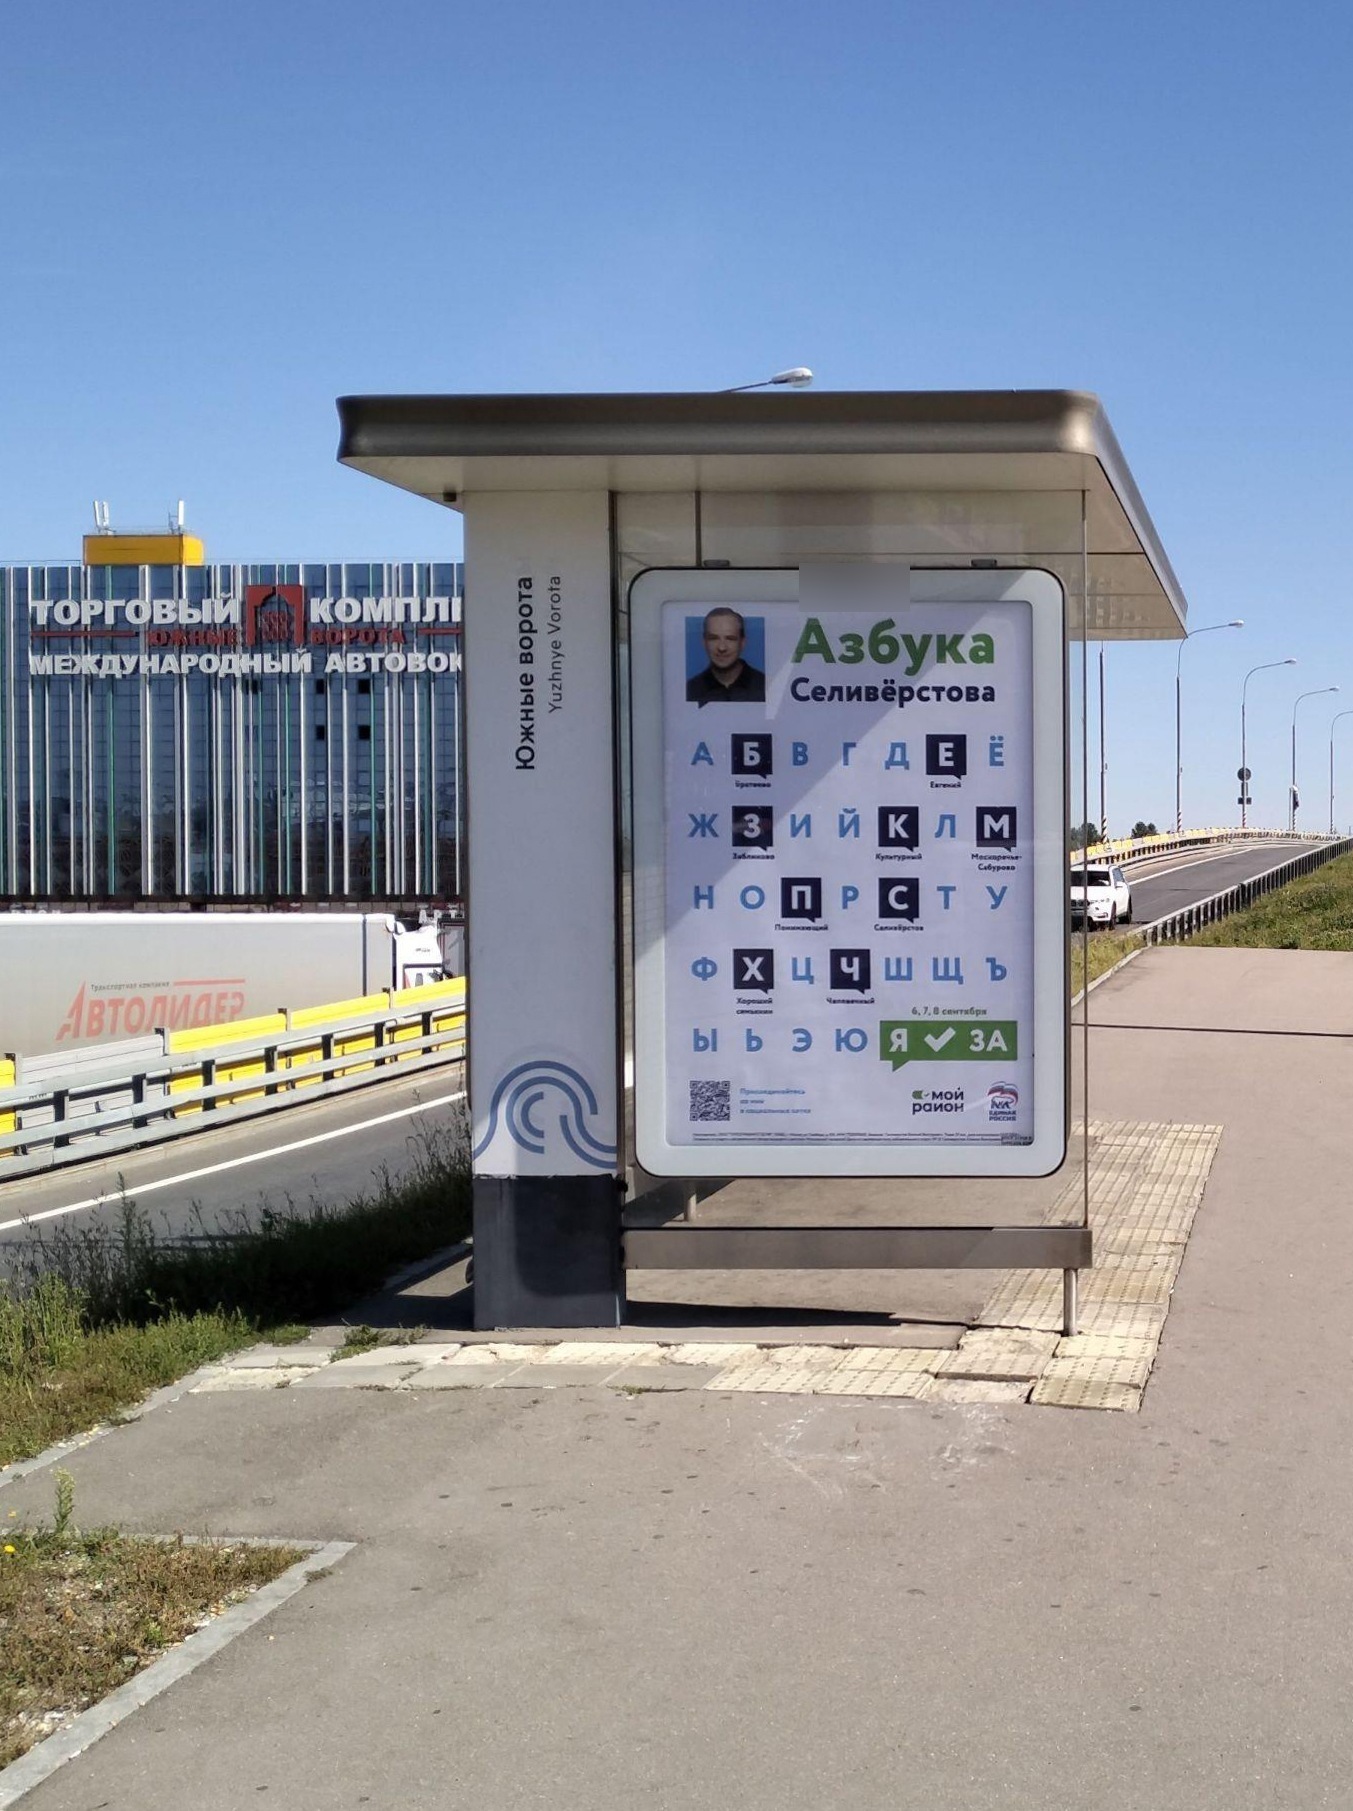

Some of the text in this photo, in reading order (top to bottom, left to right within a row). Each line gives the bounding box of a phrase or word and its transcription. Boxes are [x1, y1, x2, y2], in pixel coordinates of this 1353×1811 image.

[30, 592, 240, 626] ТОРГОВЫЙ
[147, 628, 406, 646] ЮЖНЫЕ ВОРОТА
[547, 576, 565, 713] Yuzhnye Vorota
[791, 617, 996, 676] Азбука
[30, 648, 312, 679] МЕЖДУНАРОДНЫЙ
[515, 577, 537, 770] Южные ворота
[790, 677, 995, 708] Селивёрстова
[691, 736, 1004, 770] А Б В Г Д Е Ё
[688, 808, 1009, 838] Ж З И Й К Л М
[876, 853, 922, 861] Культурный
[693, 885, 1007, 910] Н О П Р С Т У
[692, 957, 1007, 985] Ф Х Ц Ч Ш Щ Ъ
[911, 1007, 987, 1017] 6, 7, 8 сентября
[693, 1028, 868, 1052] Ы Ь Э Ю
[889, 1028, 1008, 1052] Я ЗА
